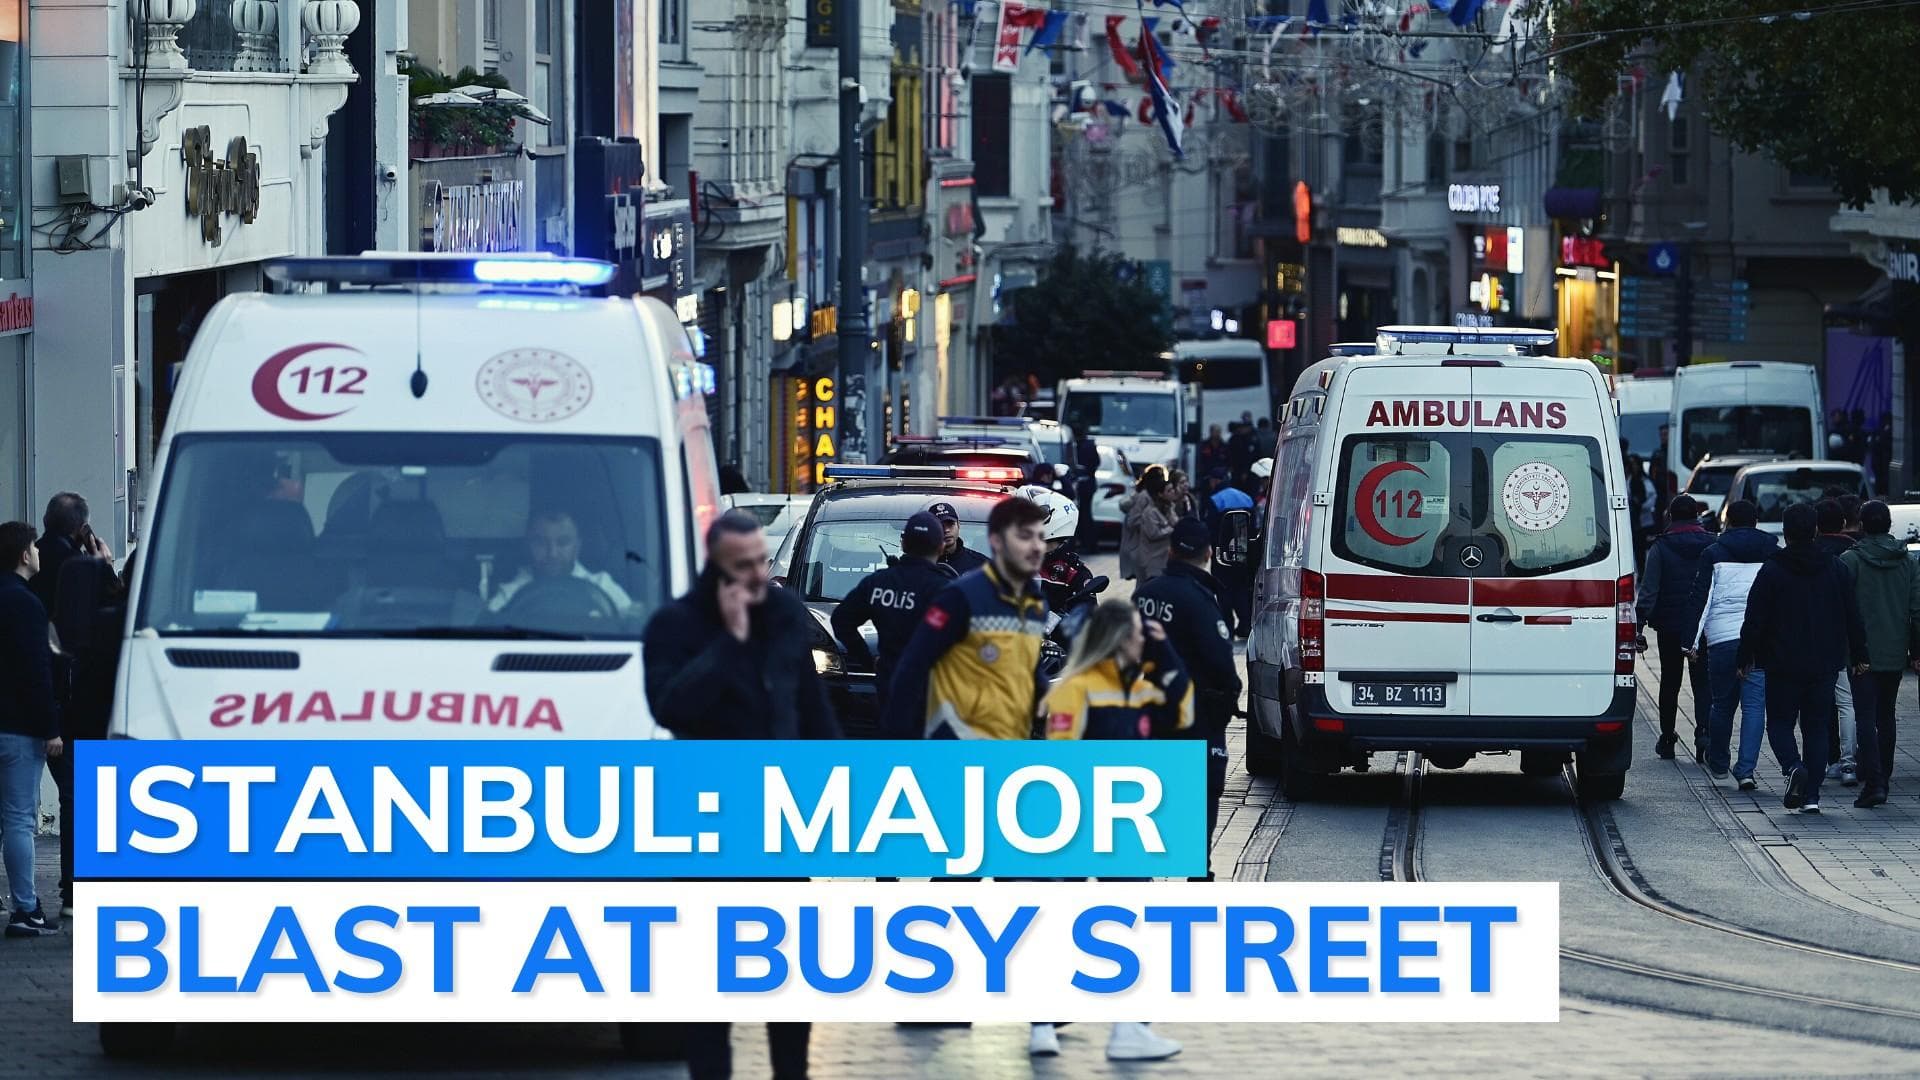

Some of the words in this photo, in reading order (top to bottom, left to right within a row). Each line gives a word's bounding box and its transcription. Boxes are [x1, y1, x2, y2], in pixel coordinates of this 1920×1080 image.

[290, 366, 368, 394] 112
[1366, 401, 1567, 429] AMBULANS
[1376, 490, 1422, 518] 112
[1358, 686, 1374, 701] 34
[1386, 686, 1402, 702] BZ
[1413, 686, 1442, 702] 1113
